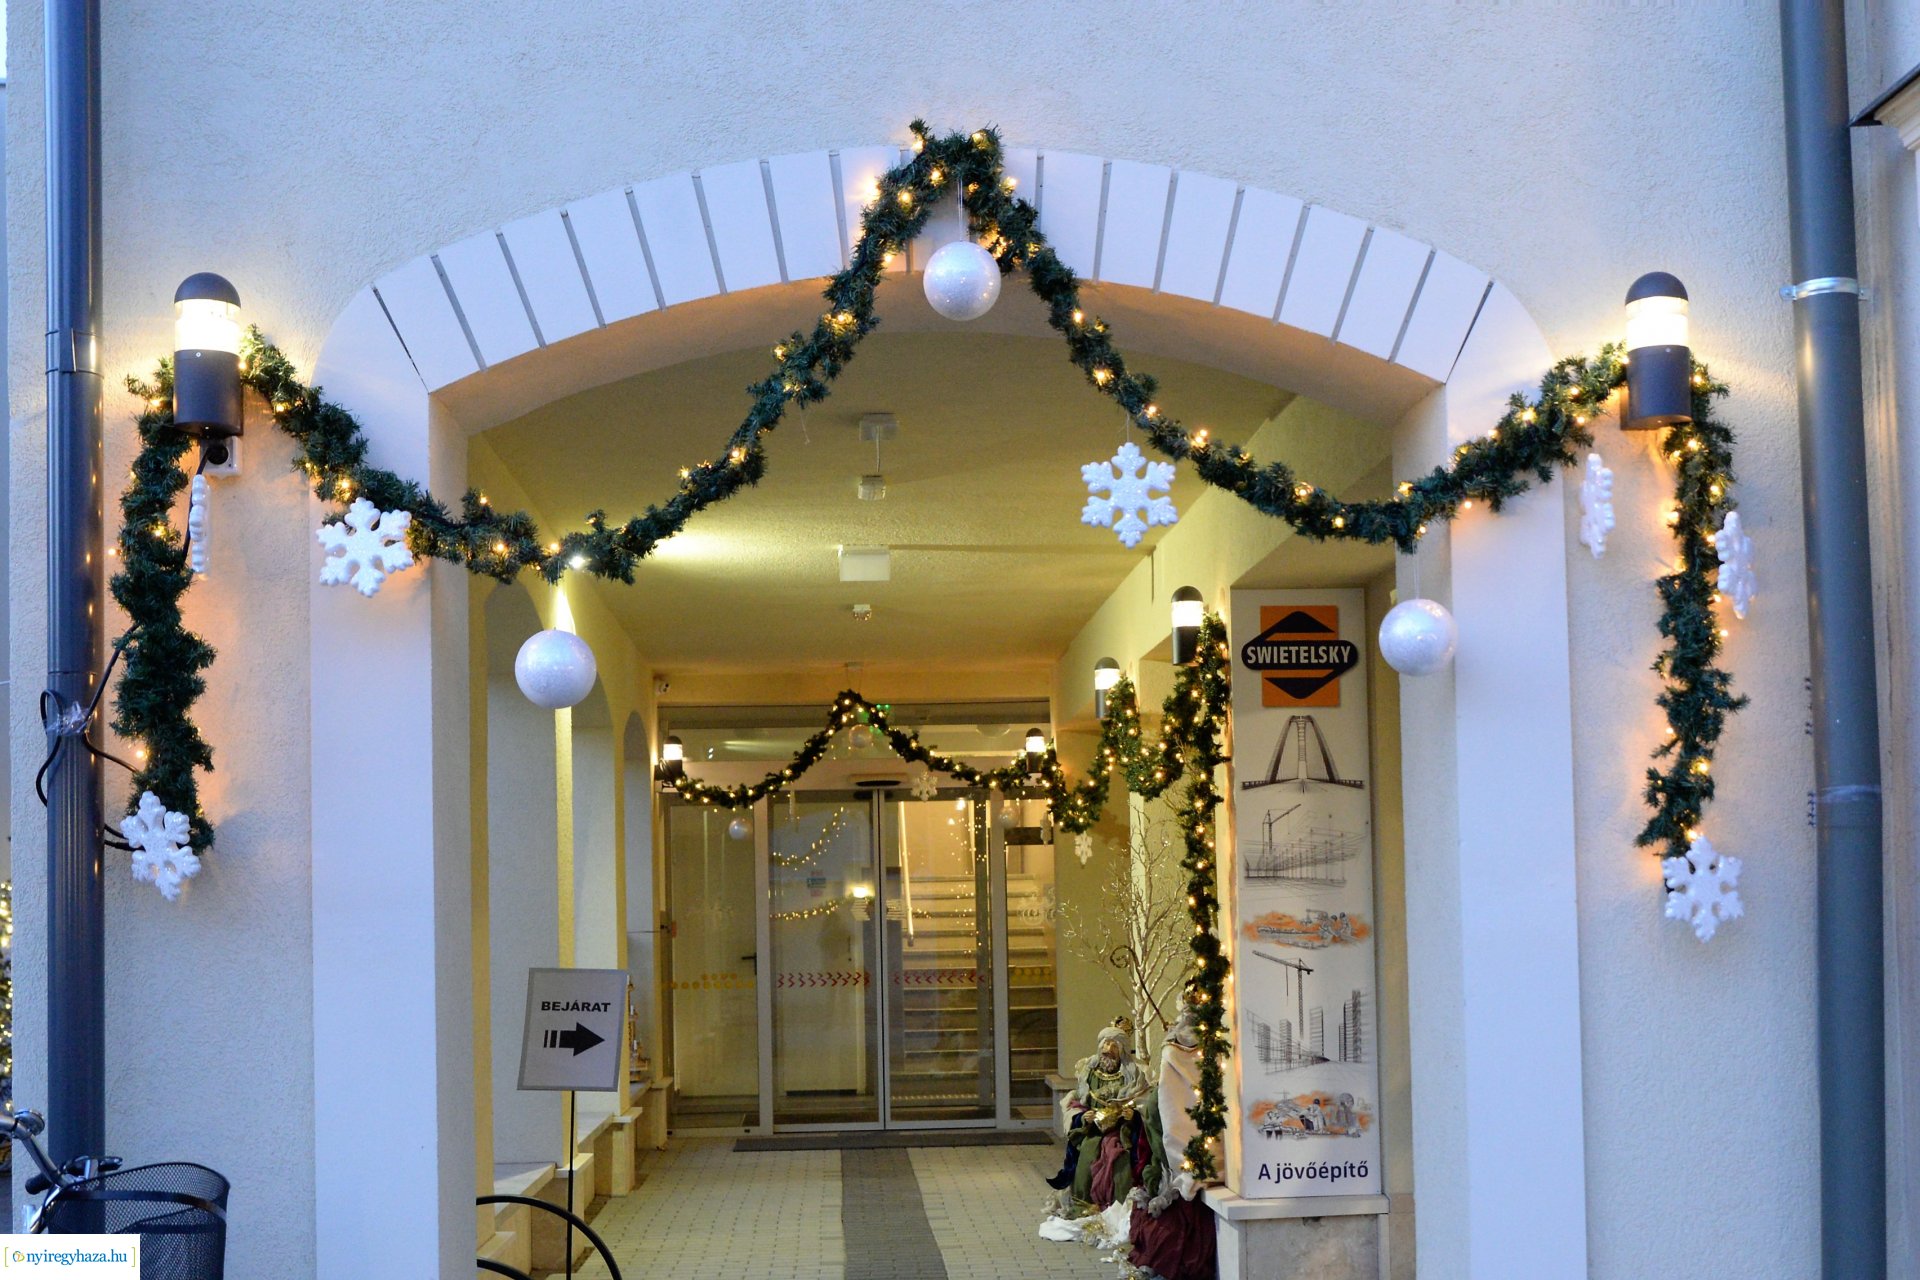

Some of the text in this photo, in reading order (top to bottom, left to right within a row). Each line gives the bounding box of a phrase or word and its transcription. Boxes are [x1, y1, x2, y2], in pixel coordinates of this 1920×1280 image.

[1246, 645, 1351, 664] SWIETELSKY
[541, 1000, 611, 1012] BEJÁRAT
[1258, 1160, 1369, 1184] A jövőépítő
